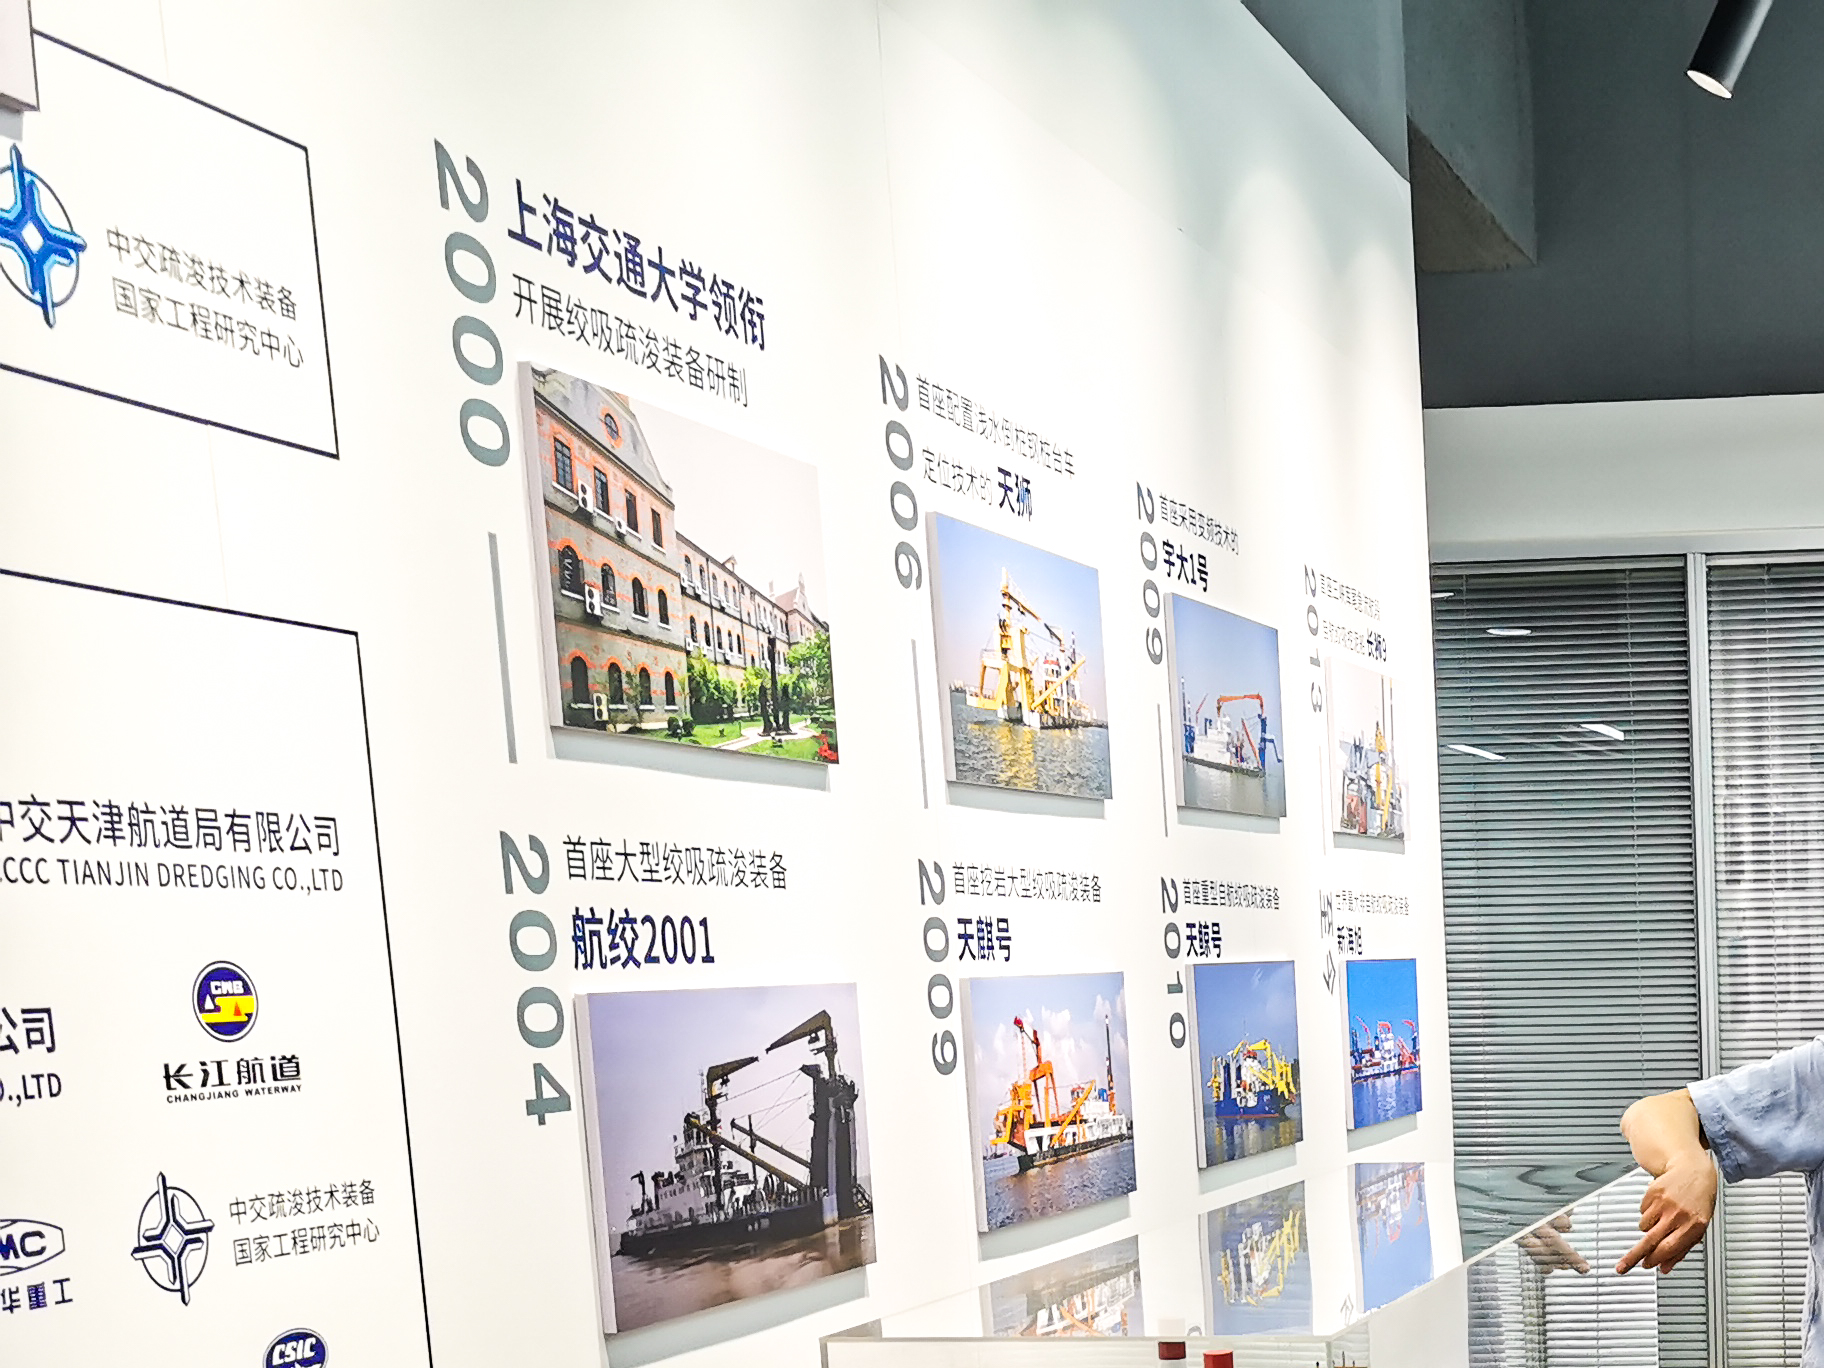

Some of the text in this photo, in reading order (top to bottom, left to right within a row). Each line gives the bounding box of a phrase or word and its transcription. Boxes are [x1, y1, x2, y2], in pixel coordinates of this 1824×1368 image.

[107, 226, 297, 321] 中交疏浚技术装备
[507, 179, 766, 351] 上海交通大学领衔
[112, 276, 304, 368] 国家工程研究中心
[434, 138, 510, 467] 2000
[512, 274, 748, 407] 开展绞吸疏浚装备研制
[879, 354, 922, 591] 2006
[922, 447, 992, 506] 定位技术的
[1136, 481, 1163, 666] 2009
[0, 856, 344, 896] CCC TIANJIN DREDGING CO.,LTD
[562, 834, 788, 890] 首座大型绞吸疏浚装备
[952, 861, 1102, 903] 首座挖岩大型绞吸疏浚装备
[572, 906, 715, 970] 航绞2001
[918, 858, 957, 1076] 2009
[1160, 876, 1186, 1049] 2010
[499, 830, 572, 1127] 2004
[0, 1007, 56, 1053] 公司
[163, 1054, 302, 1091] 长江航道
[166, 1084, 303, 1104] CHANGJIANG WATERWAY
[229, 1178, 376, 1226] 中交疏浚技术装备
[233, 1218, 380, 1267] 国家工程研究中心
[272, 1337, 317, 1366] CSIC
